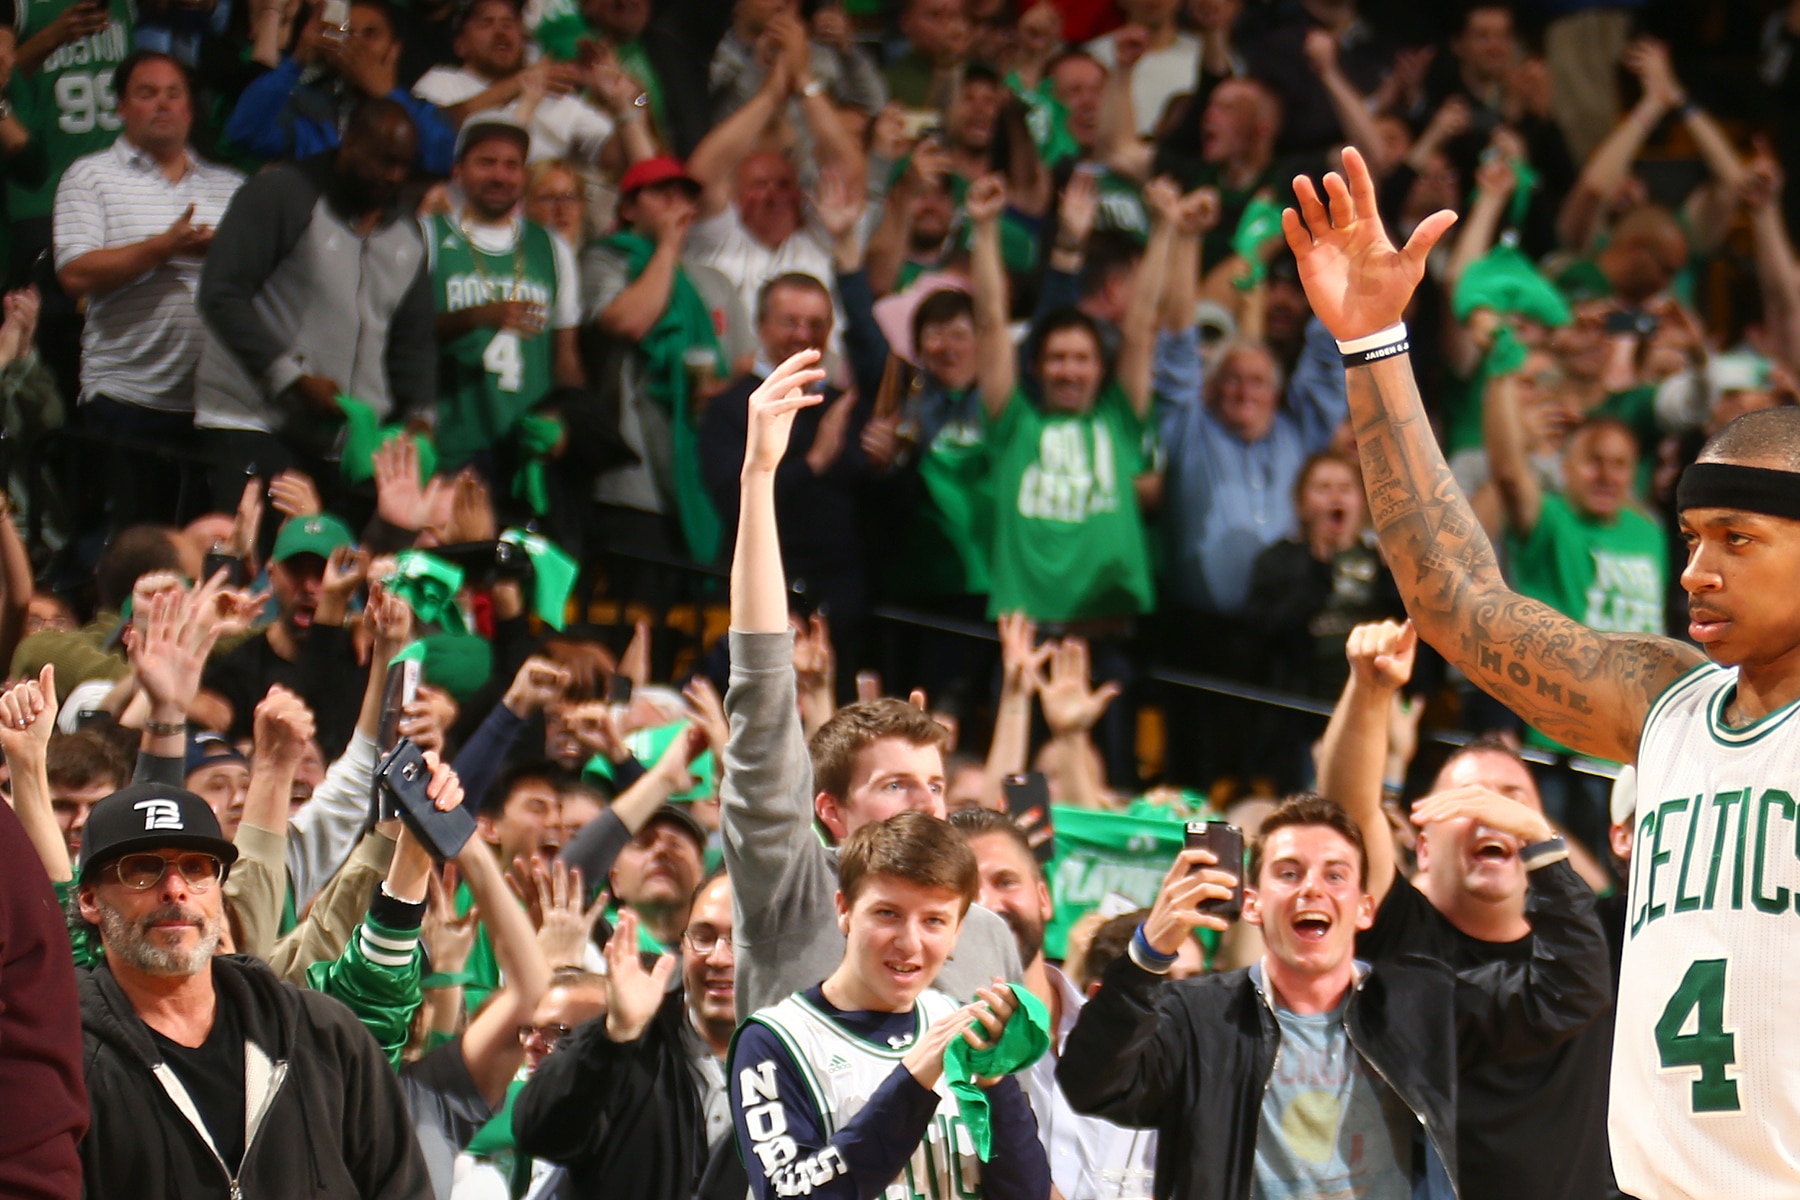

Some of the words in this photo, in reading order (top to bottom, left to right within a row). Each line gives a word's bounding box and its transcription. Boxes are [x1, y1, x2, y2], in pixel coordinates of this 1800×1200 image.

[483, 331, 523, 392] 4
[1365, 344, 1396, 361] JAIDEN
[1479, 644, 1594, 715] HOME
[1655, 957, 1742, 1114] 4
